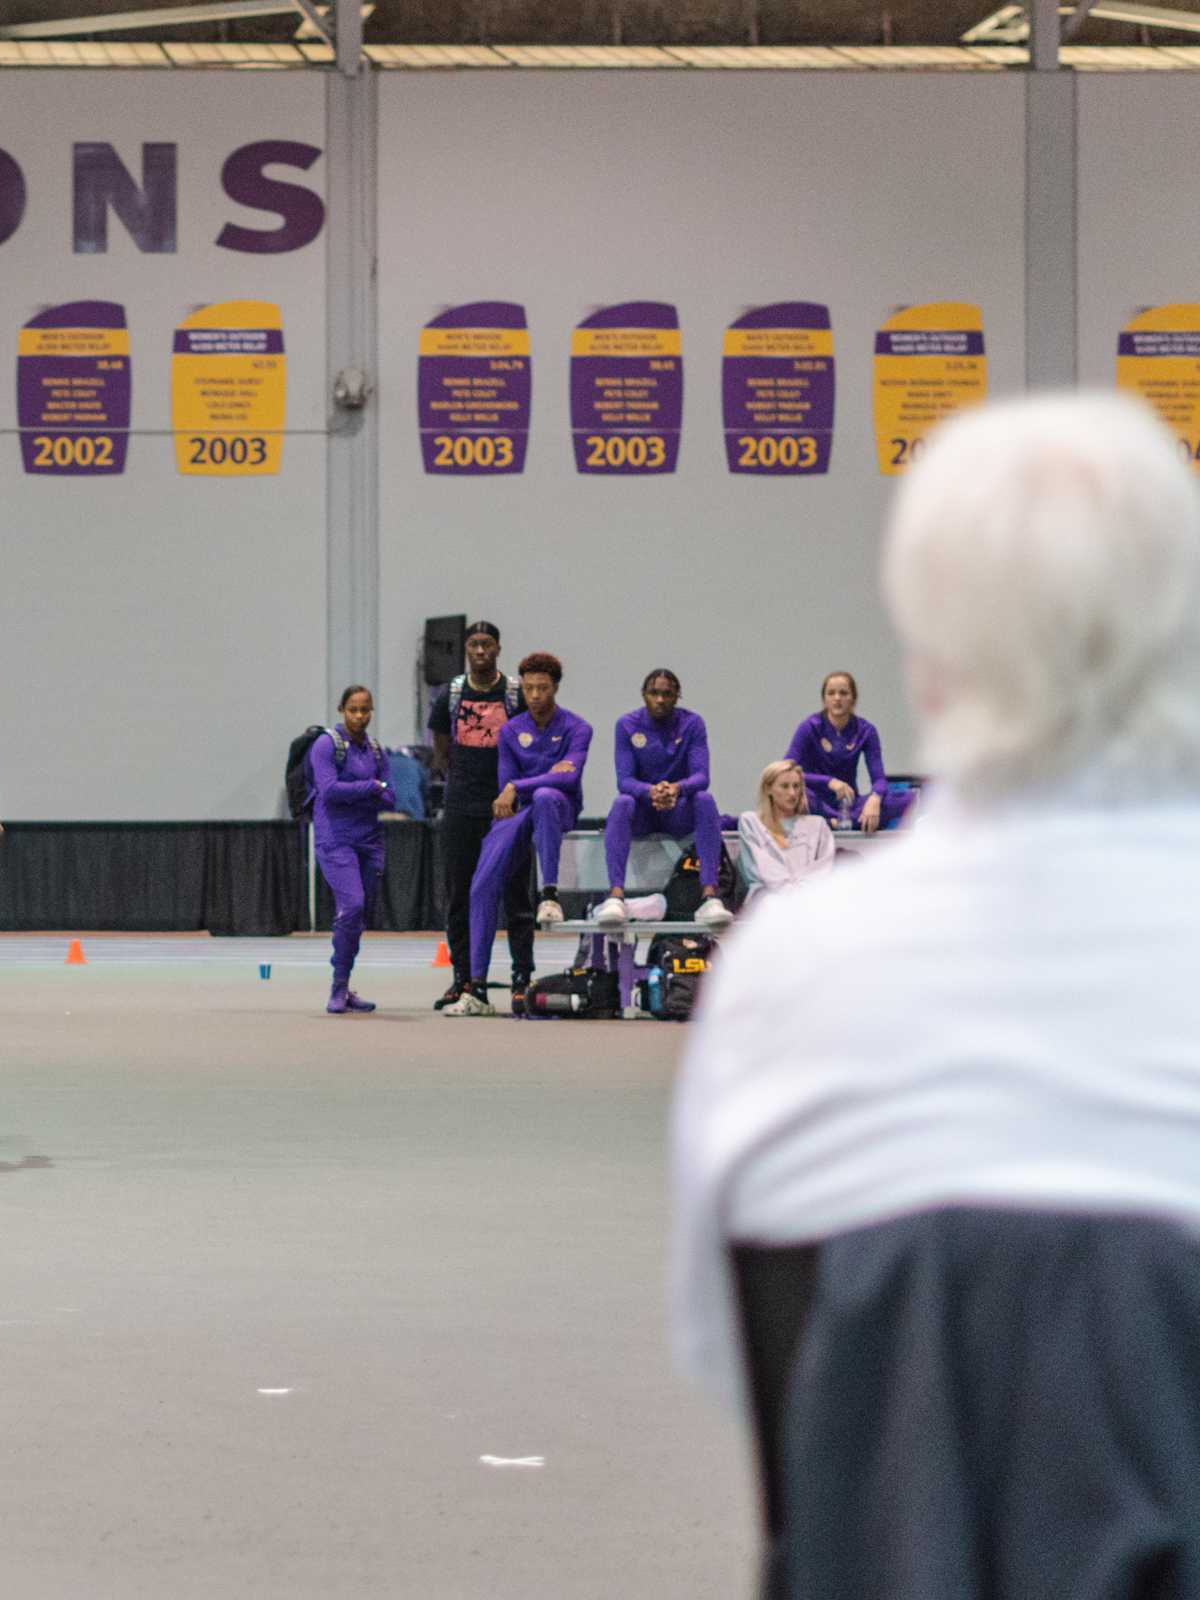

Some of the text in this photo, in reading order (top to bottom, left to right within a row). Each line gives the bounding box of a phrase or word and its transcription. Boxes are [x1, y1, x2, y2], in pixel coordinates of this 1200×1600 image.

[33, 436, 114, 467] 2002
[189, 437, 267, 466] 2003
[433, 435, 514, 467] 2003
[585, 435, 667, 467] 2003
[737, 435, 818, 467] 2003
